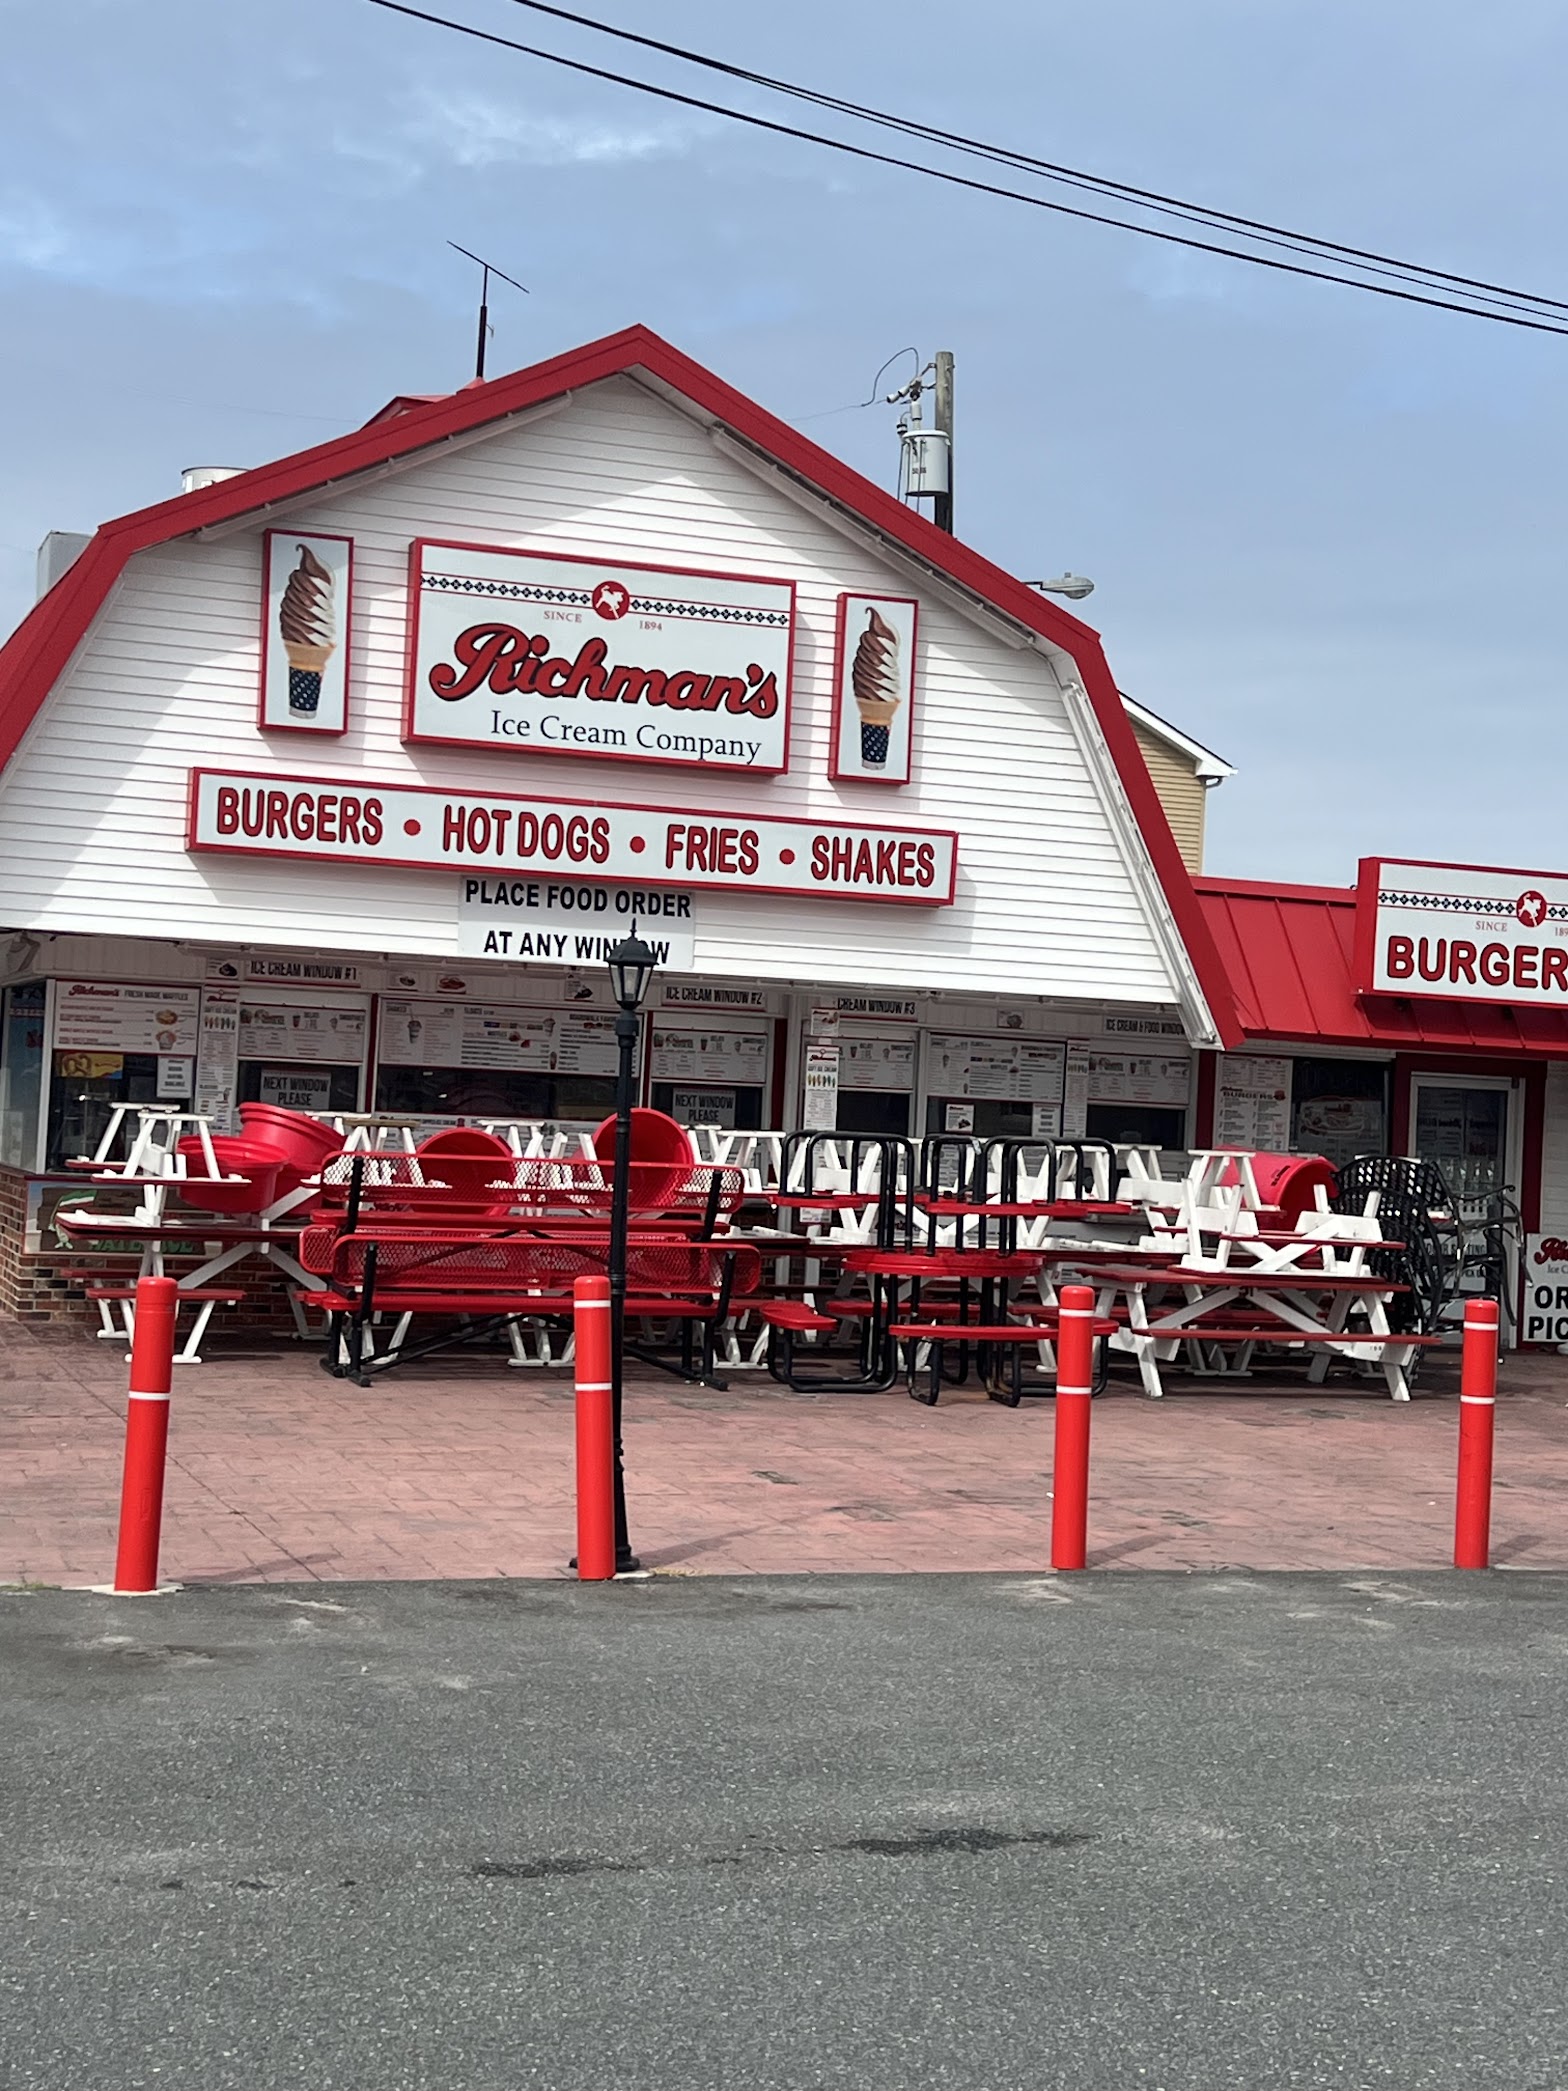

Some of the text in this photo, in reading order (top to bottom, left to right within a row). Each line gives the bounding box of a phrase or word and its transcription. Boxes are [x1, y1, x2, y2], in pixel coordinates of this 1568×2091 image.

[543, 610, 663, 631] SINCE 1894
[429, 622, 778, 719] Richman's
[490, 710, 762, 765] Ice Cream Company
[217, 787, 935, 887] BURGERS HOT DOGS FRIES SHAKES
[466, 880, 690, 918] PLACE FOOD ORDER
[1475, 920, 1508, 932] SINCE
[484, 930, 670, 964] AT ANY WINW
[250, 961, 266, 975] ICE
[267, 962, 301, 977] CREAM
[303, 964, 342, 980] WINDOW
[1387, 935, 1568, 992] BURGER
[666, 986, 763, 1005] ICE CREAM WINDOW #2
[837, 998, 916, 1015] CREAM WINDOW #3
[263, 1076, 329, 1092] NEXT WINDOW
[278, 1092, 313, 1106] PLEASE
[675, 1094, 734, 1109] NEXT WINDOW
[688, 1109, 720, 1122] PLEASE
